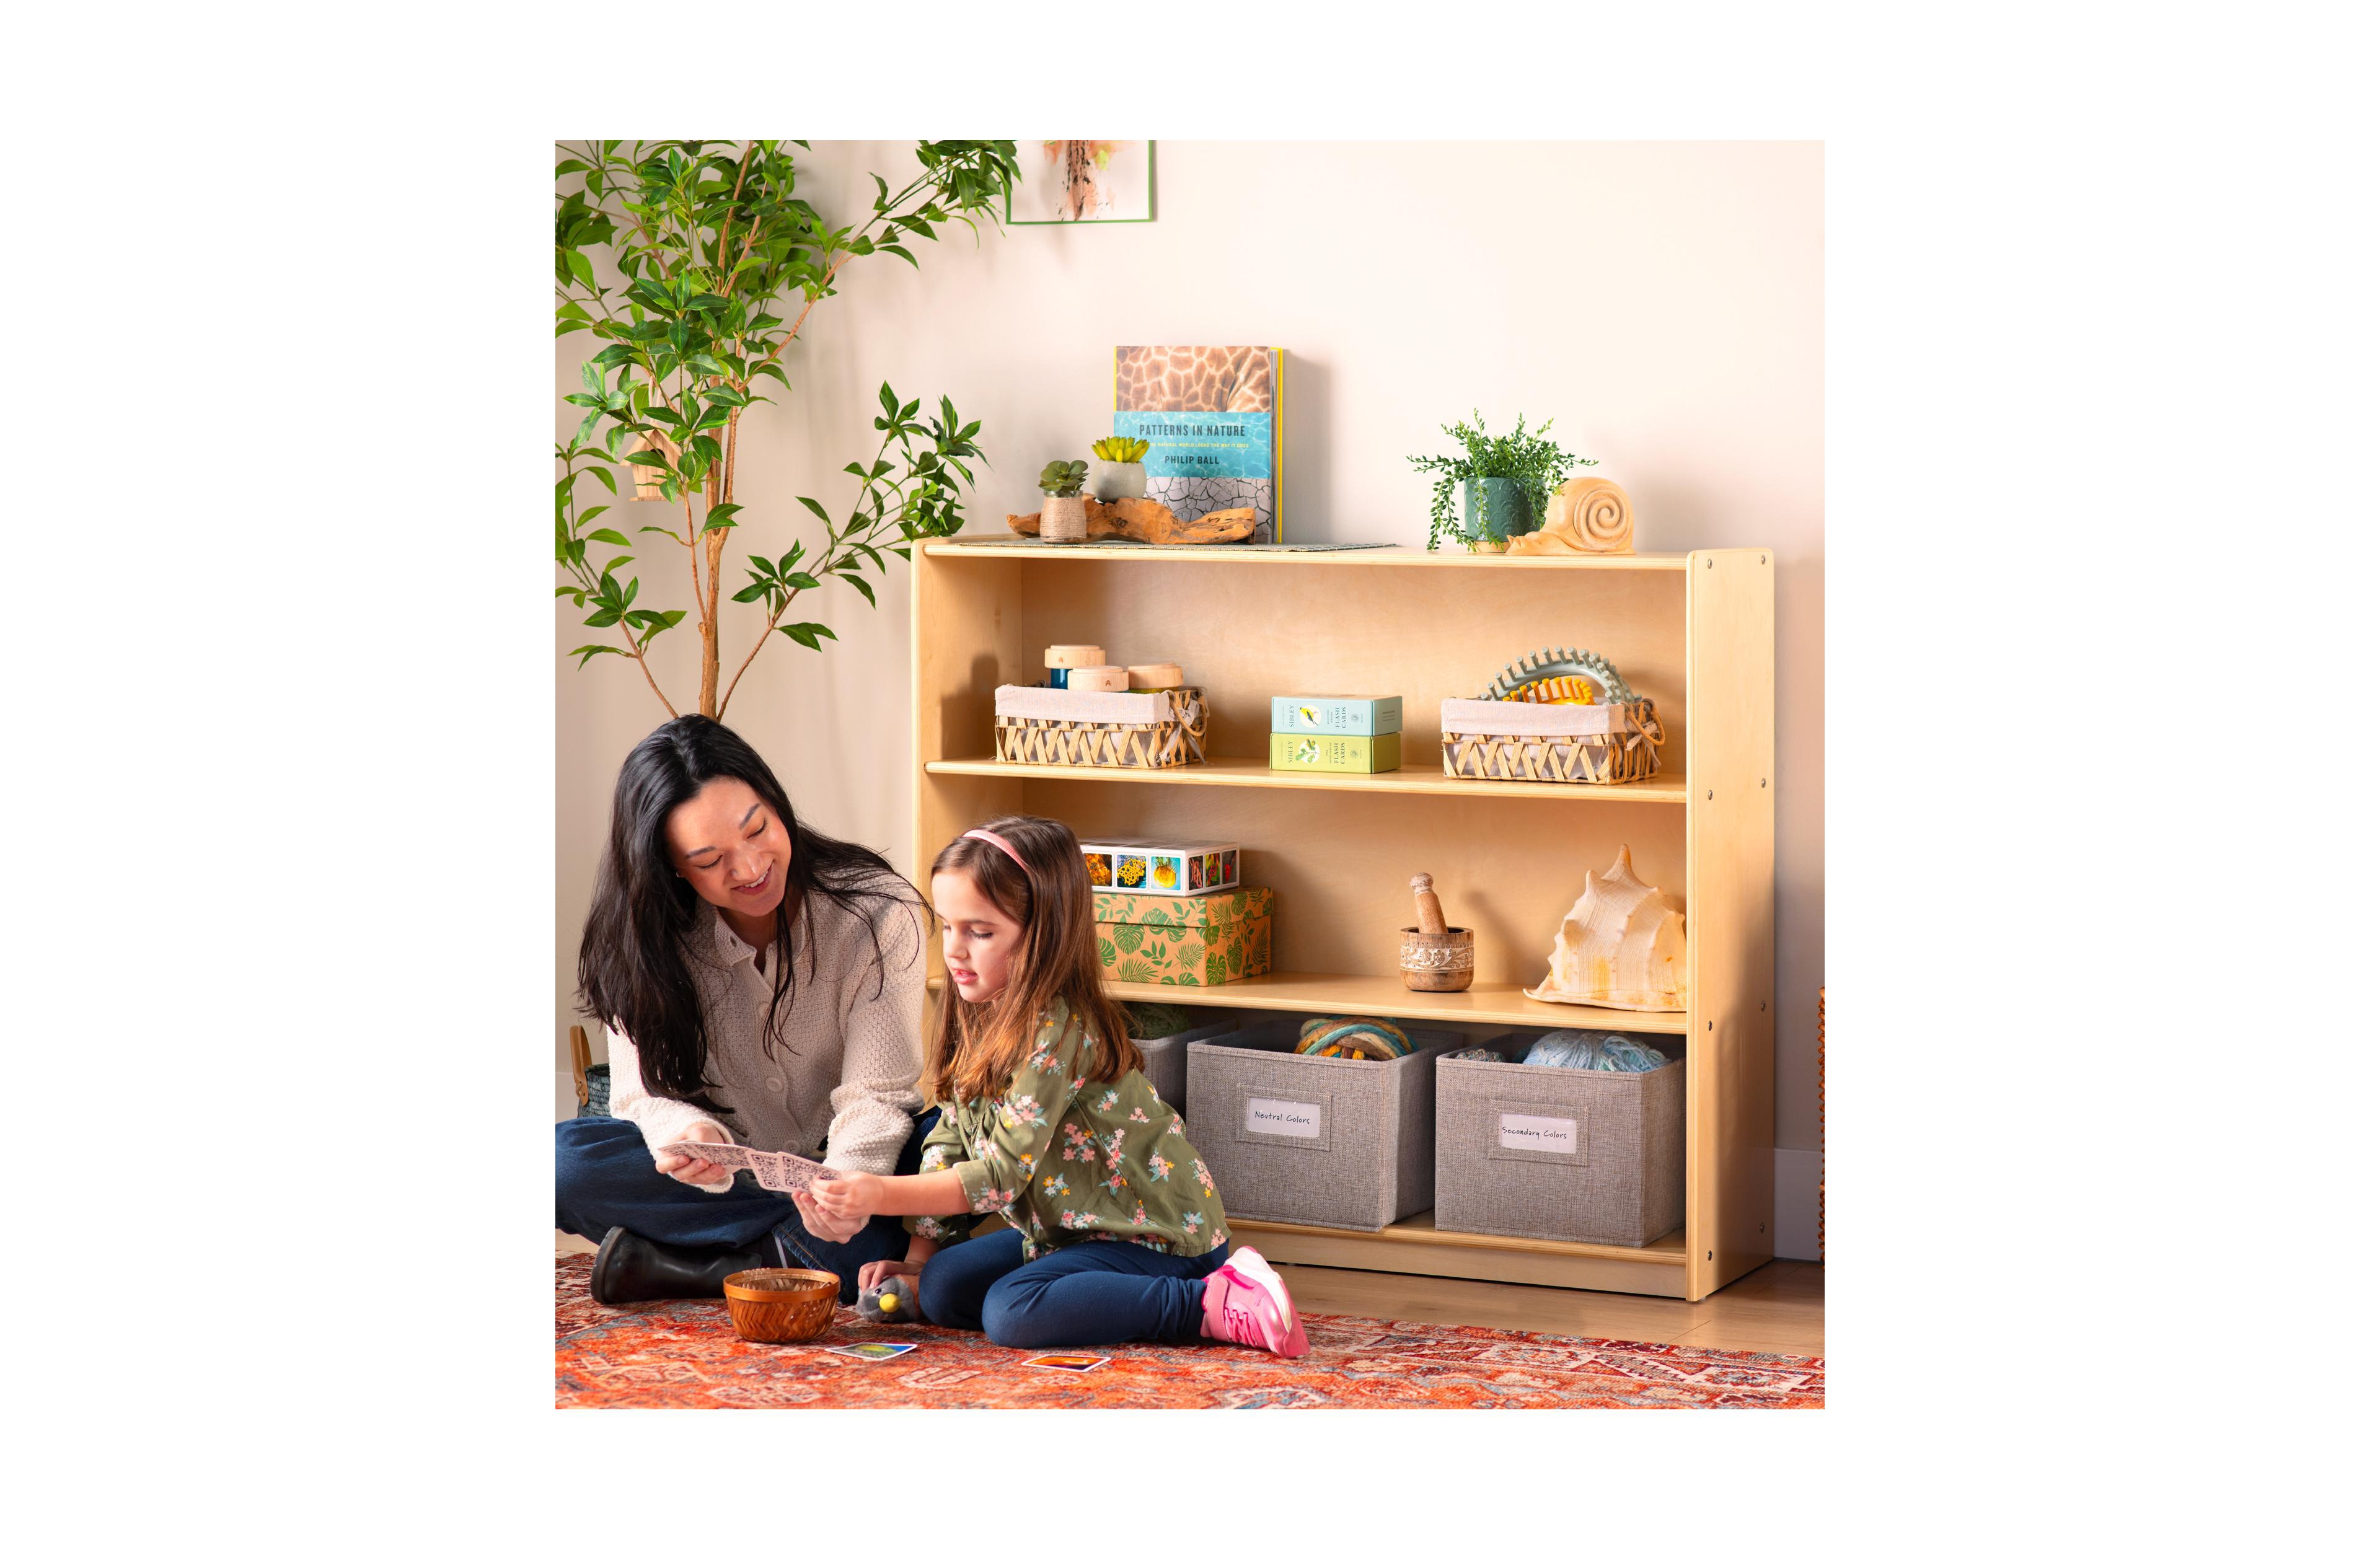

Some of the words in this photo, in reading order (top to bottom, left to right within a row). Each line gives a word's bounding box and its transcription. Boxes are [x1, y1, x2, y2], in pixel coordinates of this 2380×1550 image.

[1139, 425, 1189, 436] PATTERNS
[1192, 425, 1203, 436] IN
[1207, 425, 1245, 437] NATURE
[1165, 456, 1194, 464] PHILIP
[1197, 456, 1219, 464] BALL
[1254, 1111, 1282, 1121] Neutral
[1286, 1115, 1310, 1125] Colors
[1502, 1126, 1540, 1140] Secondary
[1543, 1130, 1567, 1139] Colors
